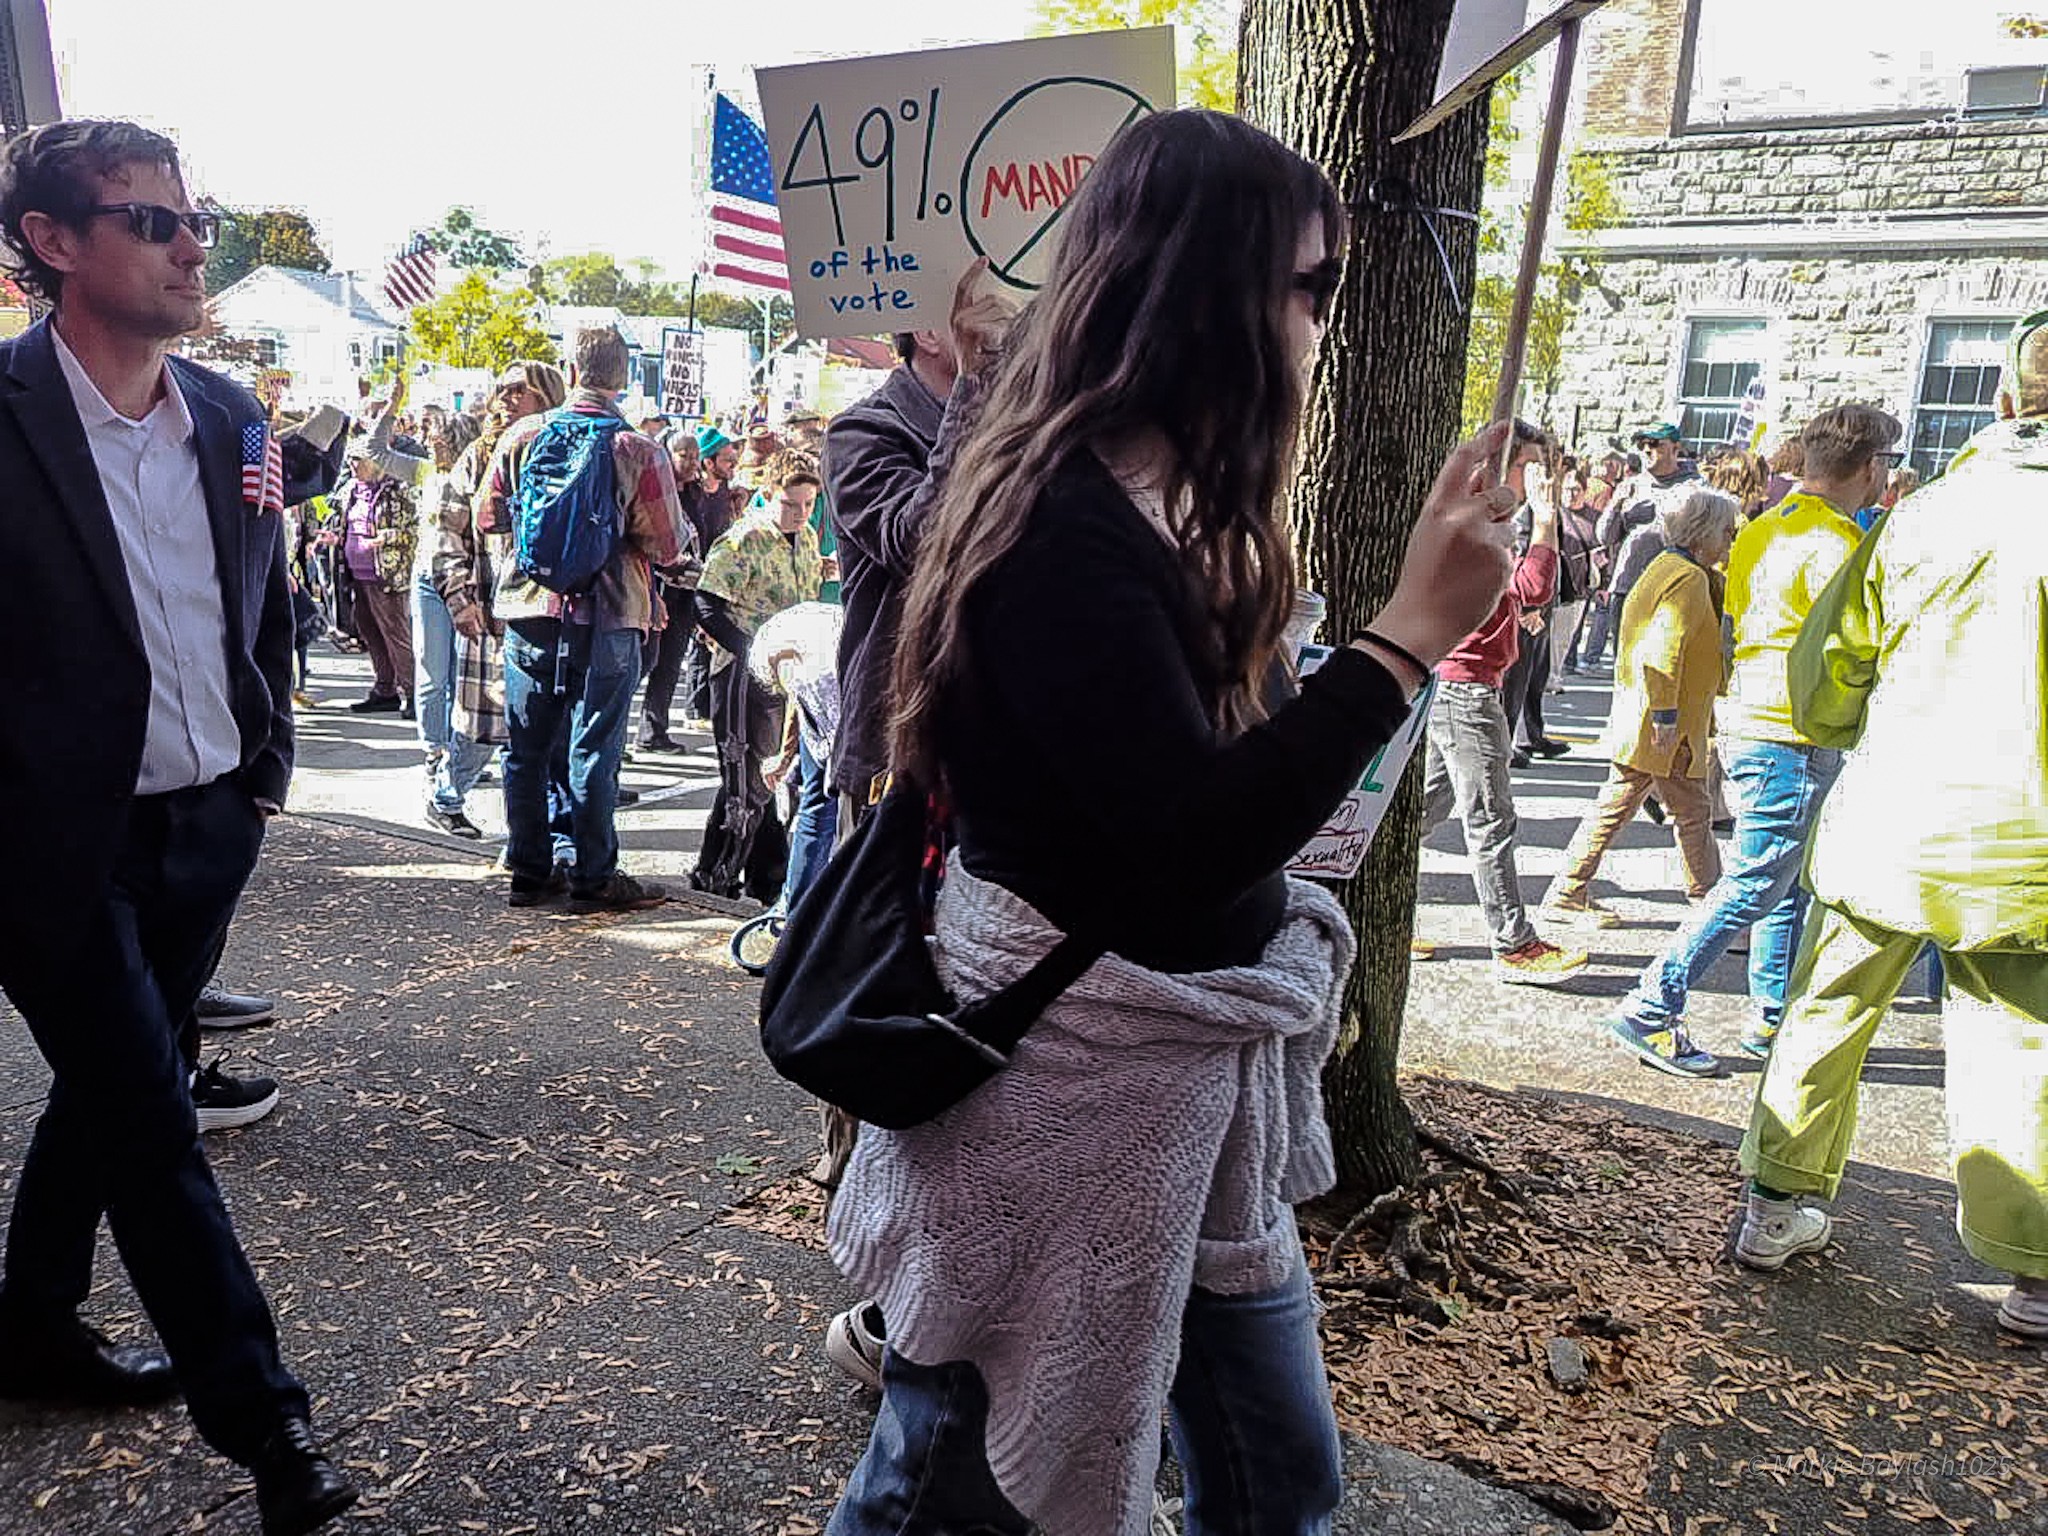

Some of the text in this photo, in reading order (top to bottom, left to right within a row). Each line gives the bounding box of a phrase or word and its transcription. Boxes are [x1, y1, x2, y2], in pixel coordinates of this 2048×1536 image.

[781, 87, 952, 247] 49%
[809, 245, 920, 279] of the
[829, 281, 915, 314] vote
[673, 334, 692, 349] NO
[670, 363, 690, 380] NO
[665, 397, 697, 414] FDT
